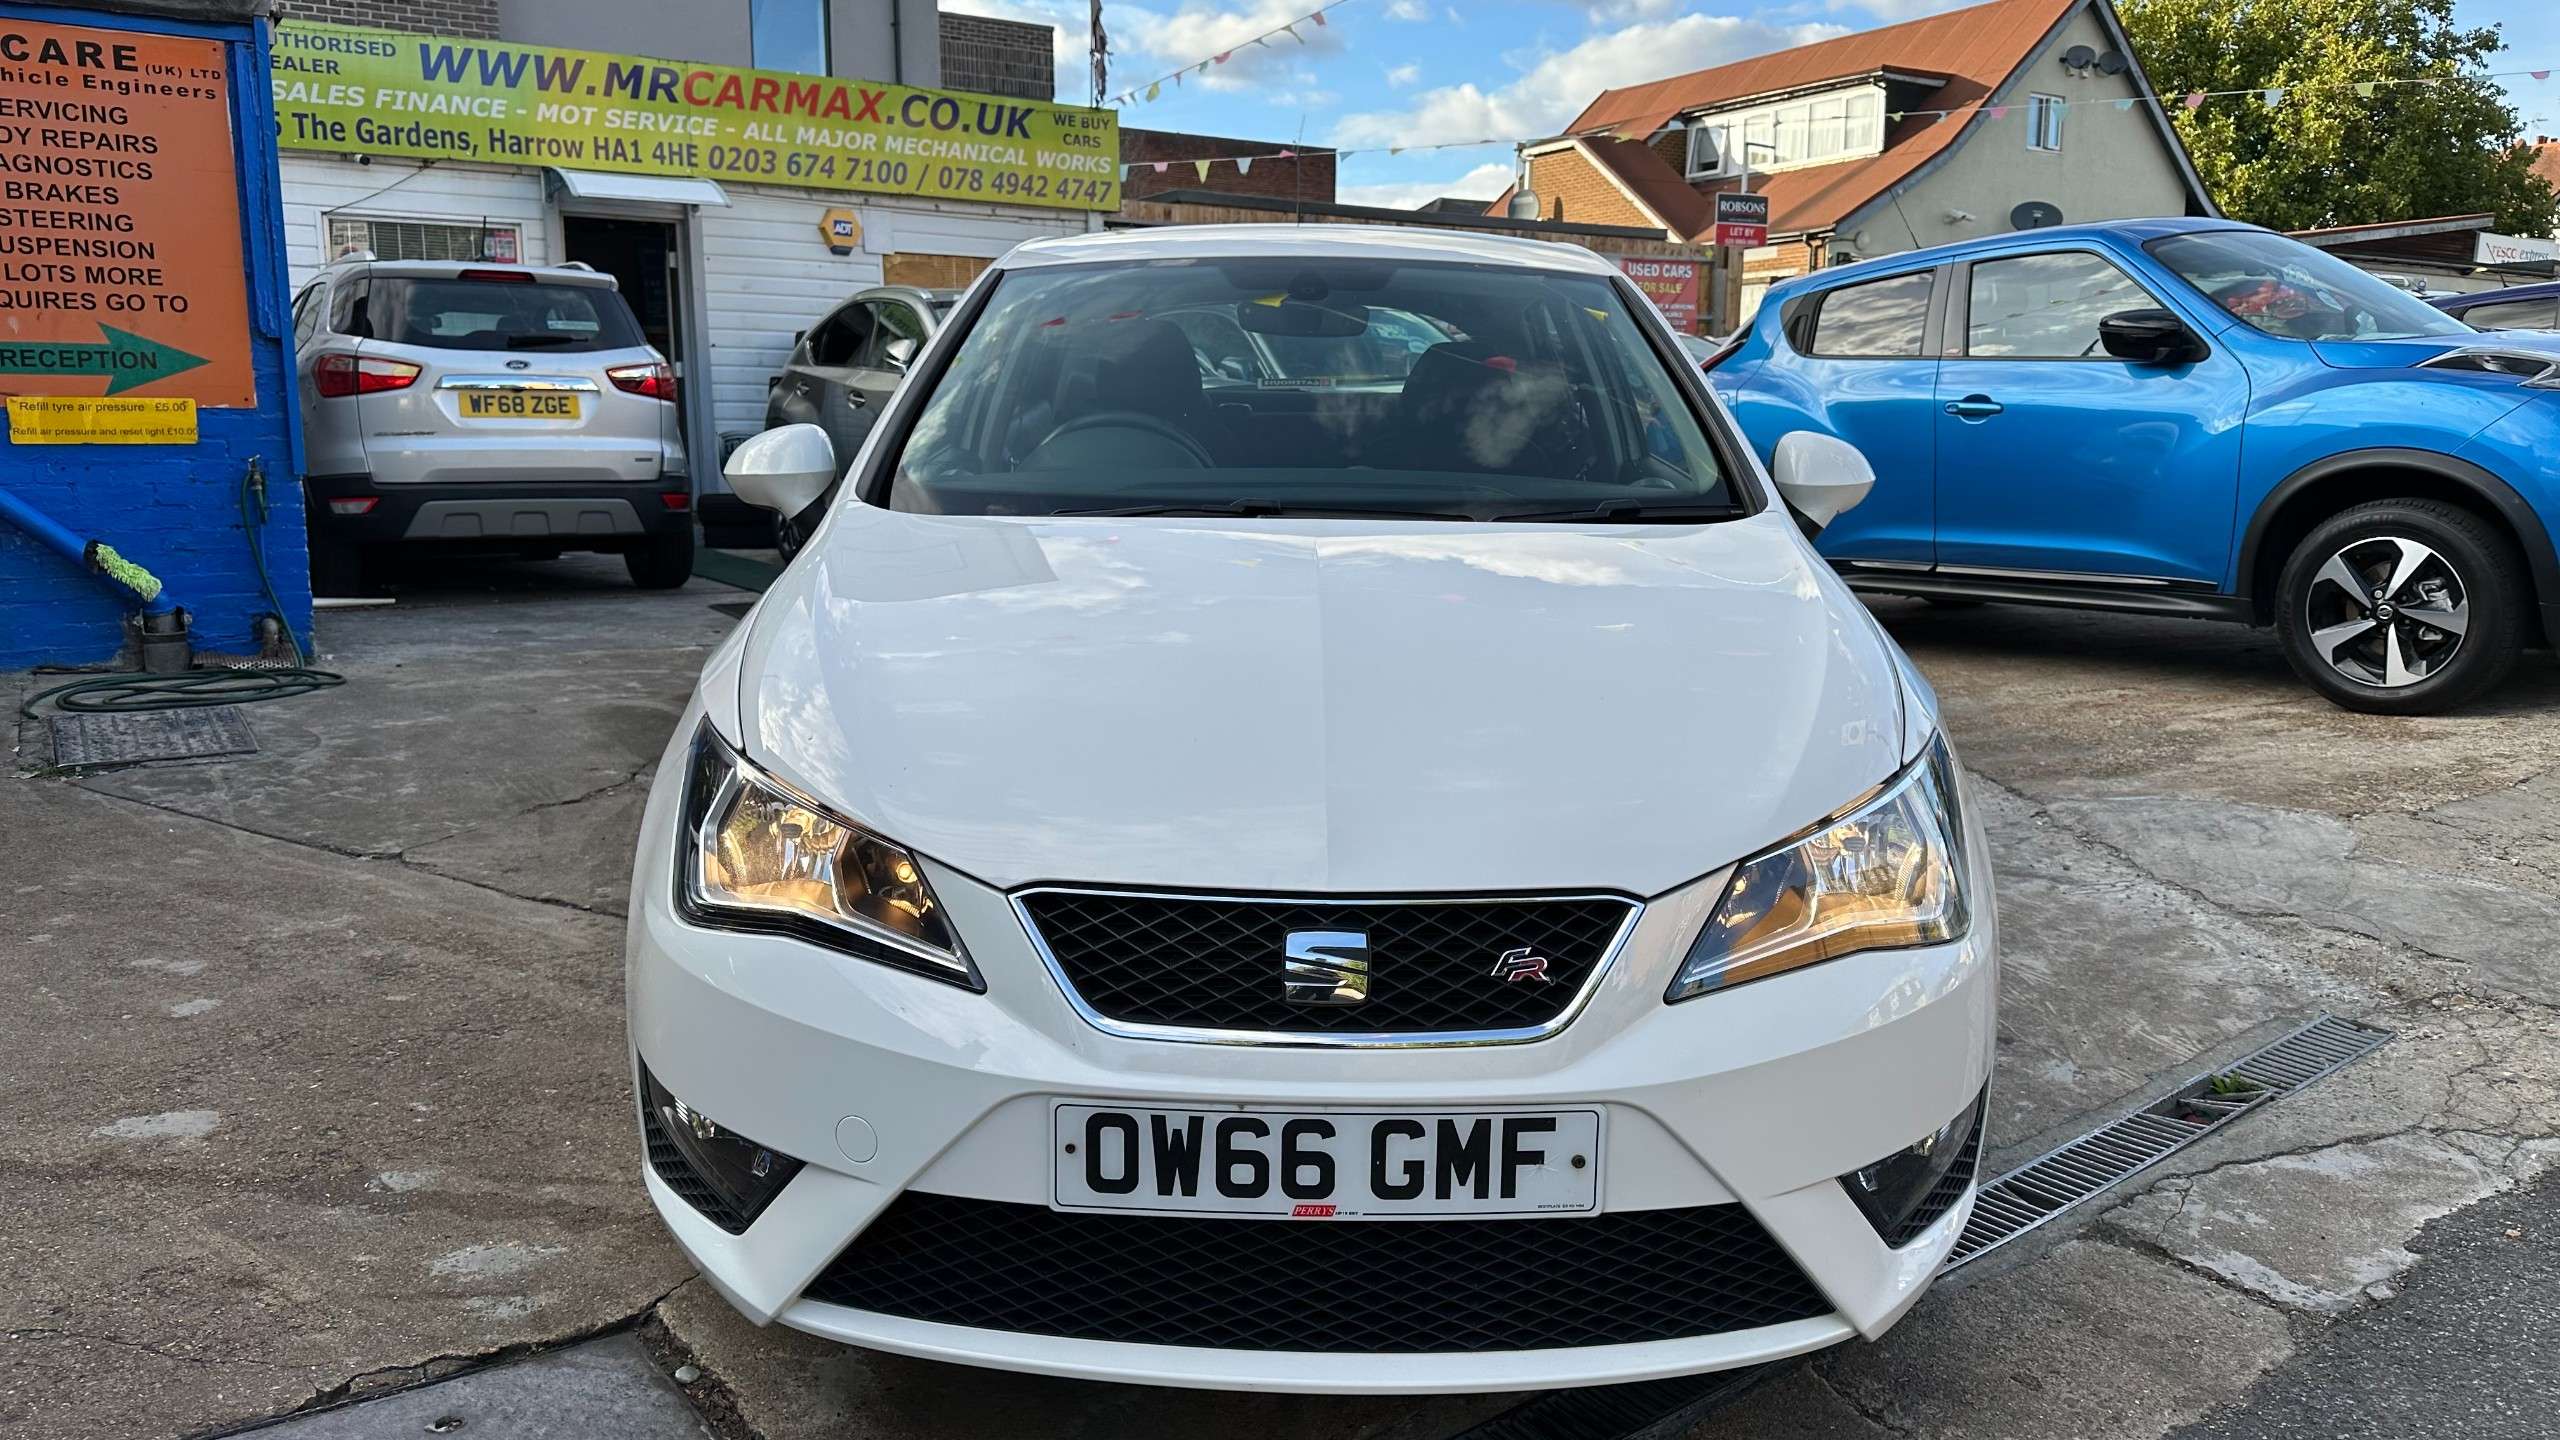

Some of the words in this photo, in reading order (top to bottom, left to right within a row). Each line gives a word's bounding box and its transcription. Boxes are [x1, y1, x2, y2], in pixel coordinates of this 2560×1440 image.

[275, 32, 396, 58] THORISED
[1, 34, 139, 72] CARE
[145, 64, 182, 79] (UK)
[191, 69, 221, 80] LTD
[83, 74, 216, 100] Engineers
[272, 79, 365, 107] SALES
[375, 88, 507, 119] FINANCE
[537, 104, 597, 126] MOT
[605, 108, 719, 137] SERVICE
[743, 121, 788, 144] ALL
[796, 126, 877, 151] MAJOR
[885, 135, 1028, 167] MECHANICAL
[1036, 151, 1112, 173] WORKS
[1053, 113, 1076, 128] WE
[1081, 115, 1111, 131] BUY
[41, 129, 158, 154] REPAIRS
[1063, 133, 1101, 149] CARS
[291, 112, 346, 142] The
[356, 117, 478, 156] Gardens,
[489, 127, 584, 159] Harrow
[594, 136, 642, 163] HA1
[652, 142, 699, 167] 4HE
[708, 145, 776, 174] 0203
[786, 152, 836, 179] 674
[844, 157, 908, 185] 7100
[939, 166, 983, 192] 078
[991, 172, 1049, 198] 4942
[1056, 177, 1113, 203] 4747
[5, 181, 119, 205] BRAKES
[1720, 200, 1766, 215] ROBSONS
[0, 208, 134, 232] STEERING
[834, 222, 852, 234] ADT
[1729, 226, 1743, 237] LET
[1744, 227, 1755, 238] BY
[4, 263, 76, 283] LOTS
[85, 266, 164, 286] MORE
[1628, 262, 1660, 277] USED
[1662, 264, 1693, 279] CARS
[1639, 281, 1657, 293] FOR
[1659, 282, 1683, 294] SALE
[106, 293, 146, 312] GO
[153, 294, 188, 314] TO
[0, 350, 158, 370] RECEPTION
[19, 402, 49, 412] Refill
[52, 402, 73, 413] tyre
[78, 402, 91, 412] air
[95, 403, 145, 413] pressure
[155, 402, 187, 413] £5.00
[469, 395, 525, 414] WF68
[531, 396, 571, 414] ZGE
[13, 427, 37, 436] Refill
[40, 428, 51, 436] air
[55, 428, 97, 438] pressure
[100, 427, 117, 436] and
[120, 427, 143, 436] reset
[1085, 1112, 1337, 1200] OW66
[1370, 1116, 1557, 1200] GMF
[1294, 1206, 1335, 1216] PERRYS
